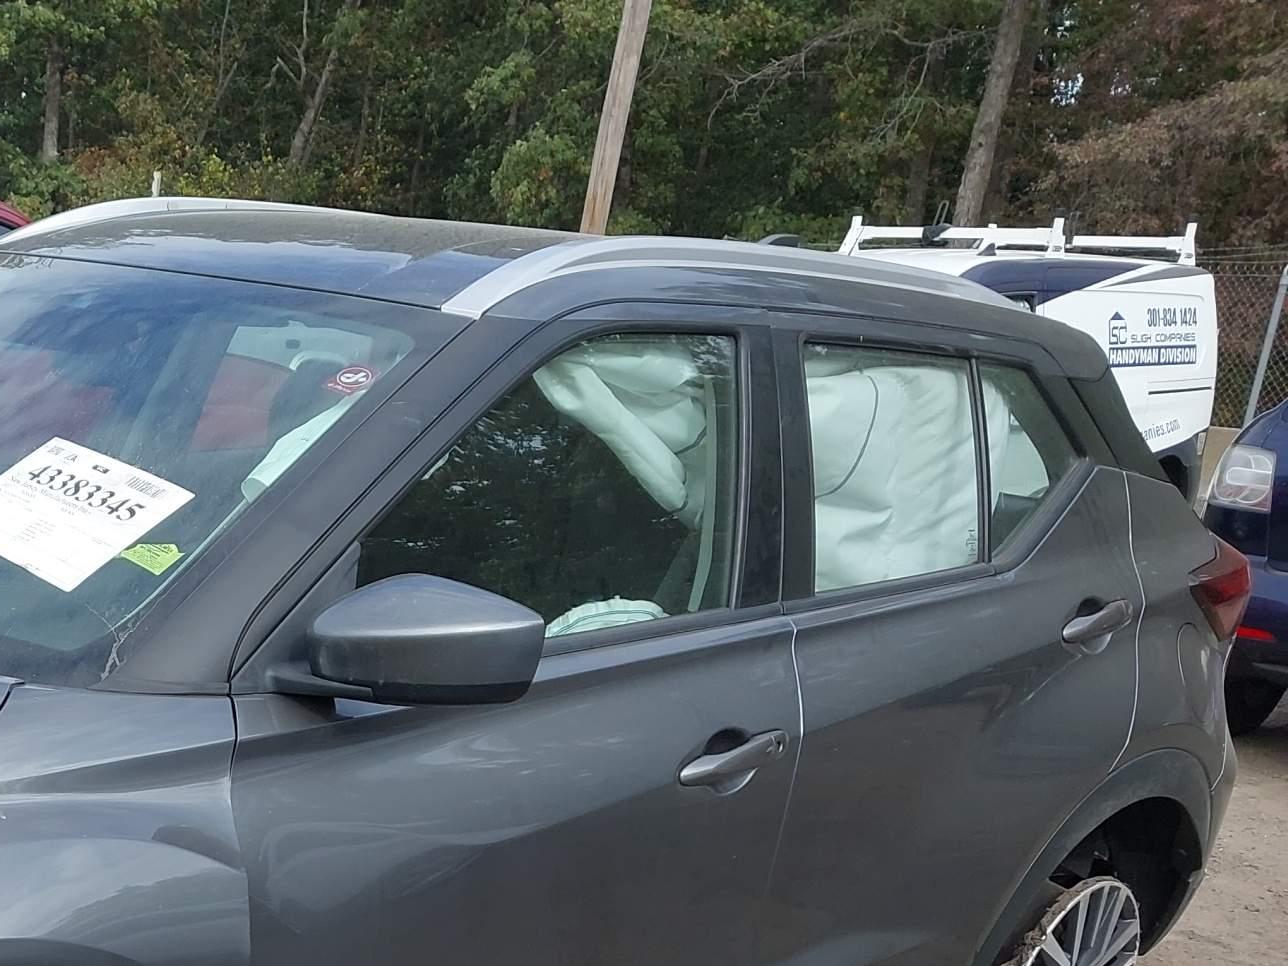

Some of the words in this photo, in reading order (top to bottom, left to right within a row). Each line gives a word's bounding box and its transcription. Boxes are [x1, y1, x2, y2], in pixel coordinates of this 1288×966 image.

[1146, 307, 1177, 327] 301-834
[1179, 307, 1197, 327] 1424
[1155, 332, 1197, 343] COMPANIES
[1110, 347, 1158, 365] HANDYMAN
[1159, 346, 1196, 362] DIVISION
[1142, 419, 1181, 441] anies.com
[28, 464, 147, 521] 43383345
